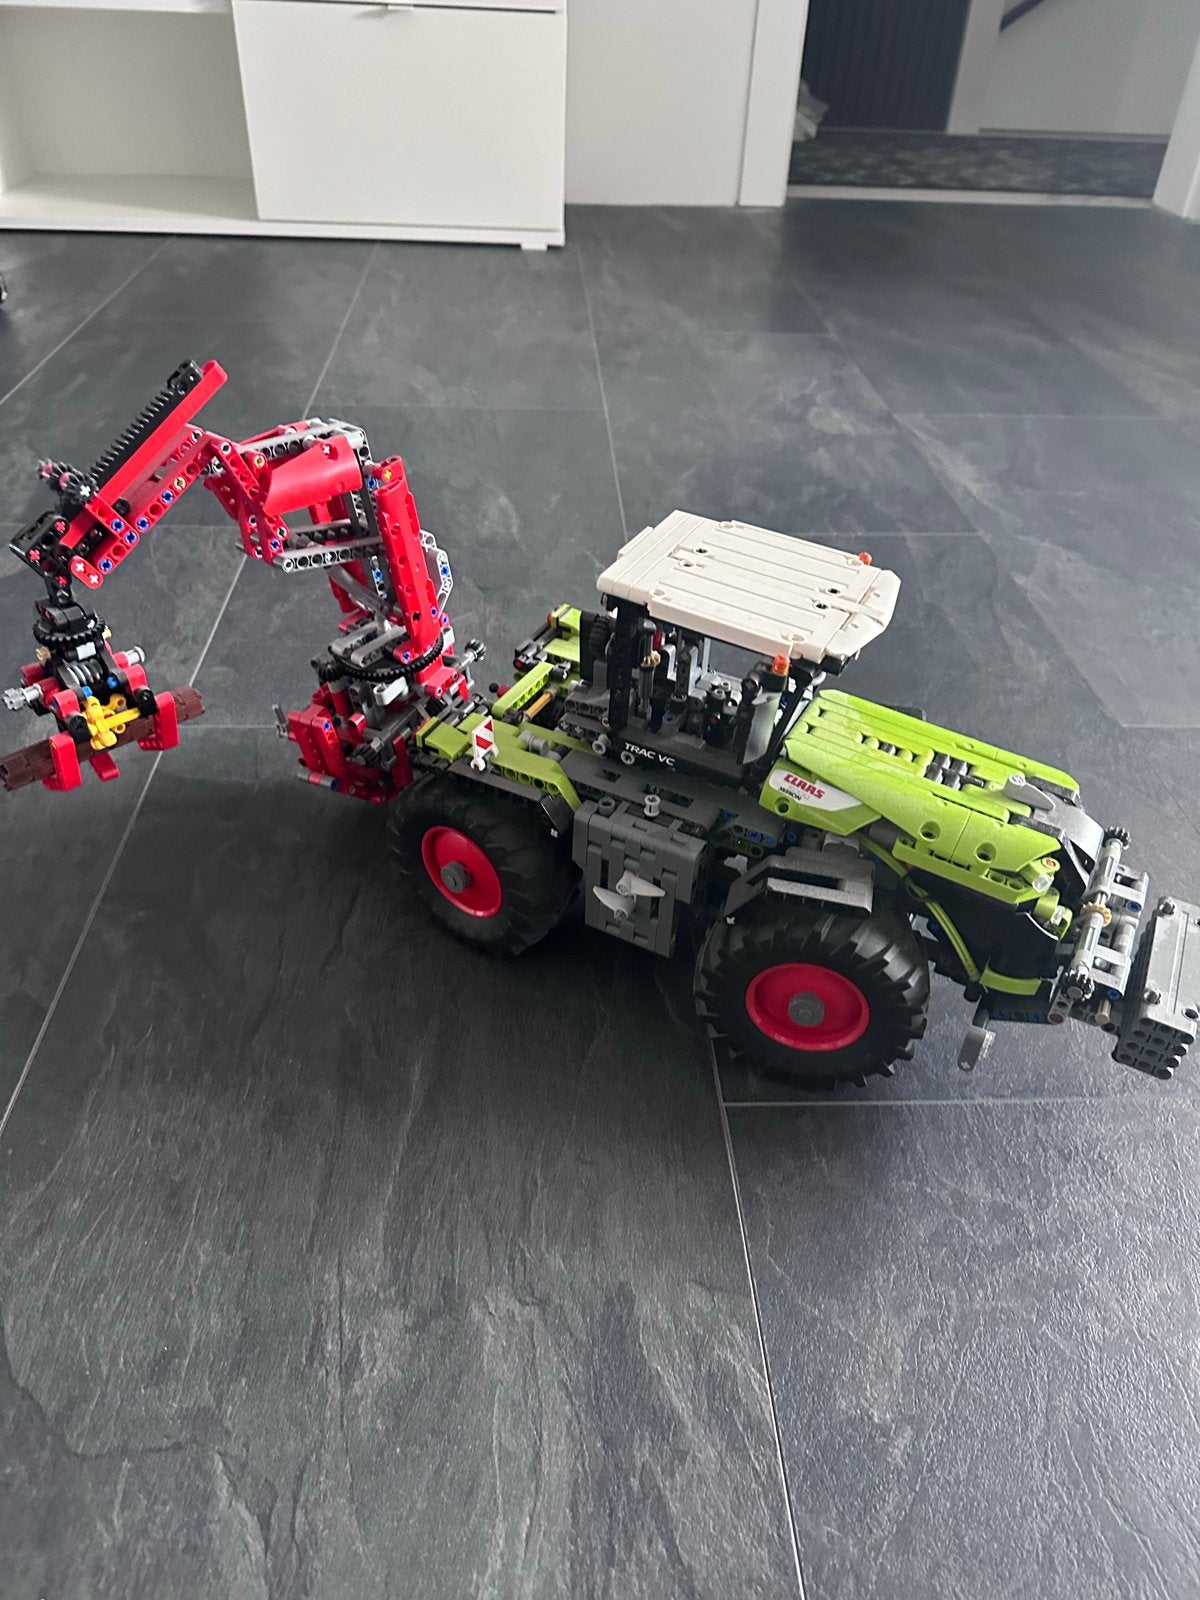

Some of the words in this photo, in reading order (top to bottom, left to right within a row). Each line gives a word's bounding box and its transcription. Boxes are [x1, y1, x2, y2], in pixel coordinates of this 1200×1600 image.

[624, 742, 656, 760] TRAC
[658, 754, 676, 767] VC
[783, 773, 826, 799] CLAAS
